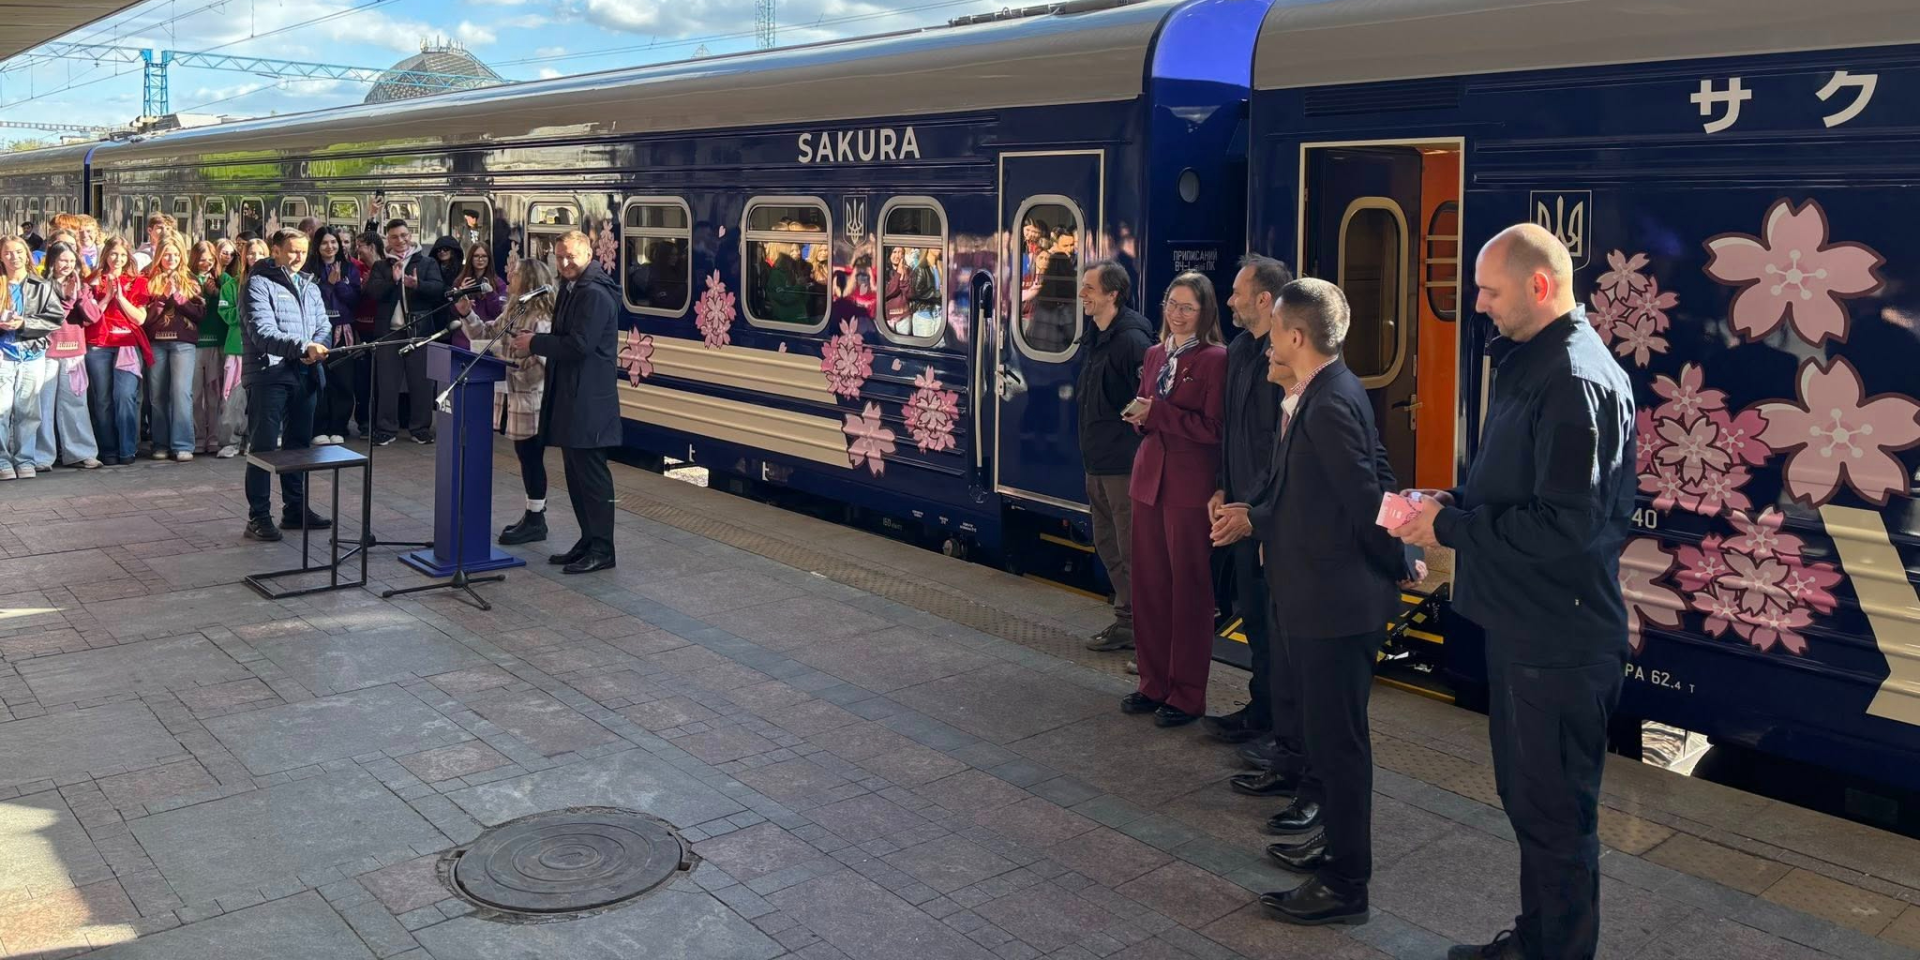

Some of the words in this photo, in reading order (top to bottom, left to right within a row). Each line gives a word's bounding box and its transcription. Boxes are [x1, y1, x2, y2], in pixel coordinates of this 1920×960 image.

[798, 126, 920, 163] SAKURA
[300, 160, 338, 178] САКУРА
[1173, 248, 1218, 261] ПРИПИСАНИЙ
[1624, 662, 1645, 681] РА
